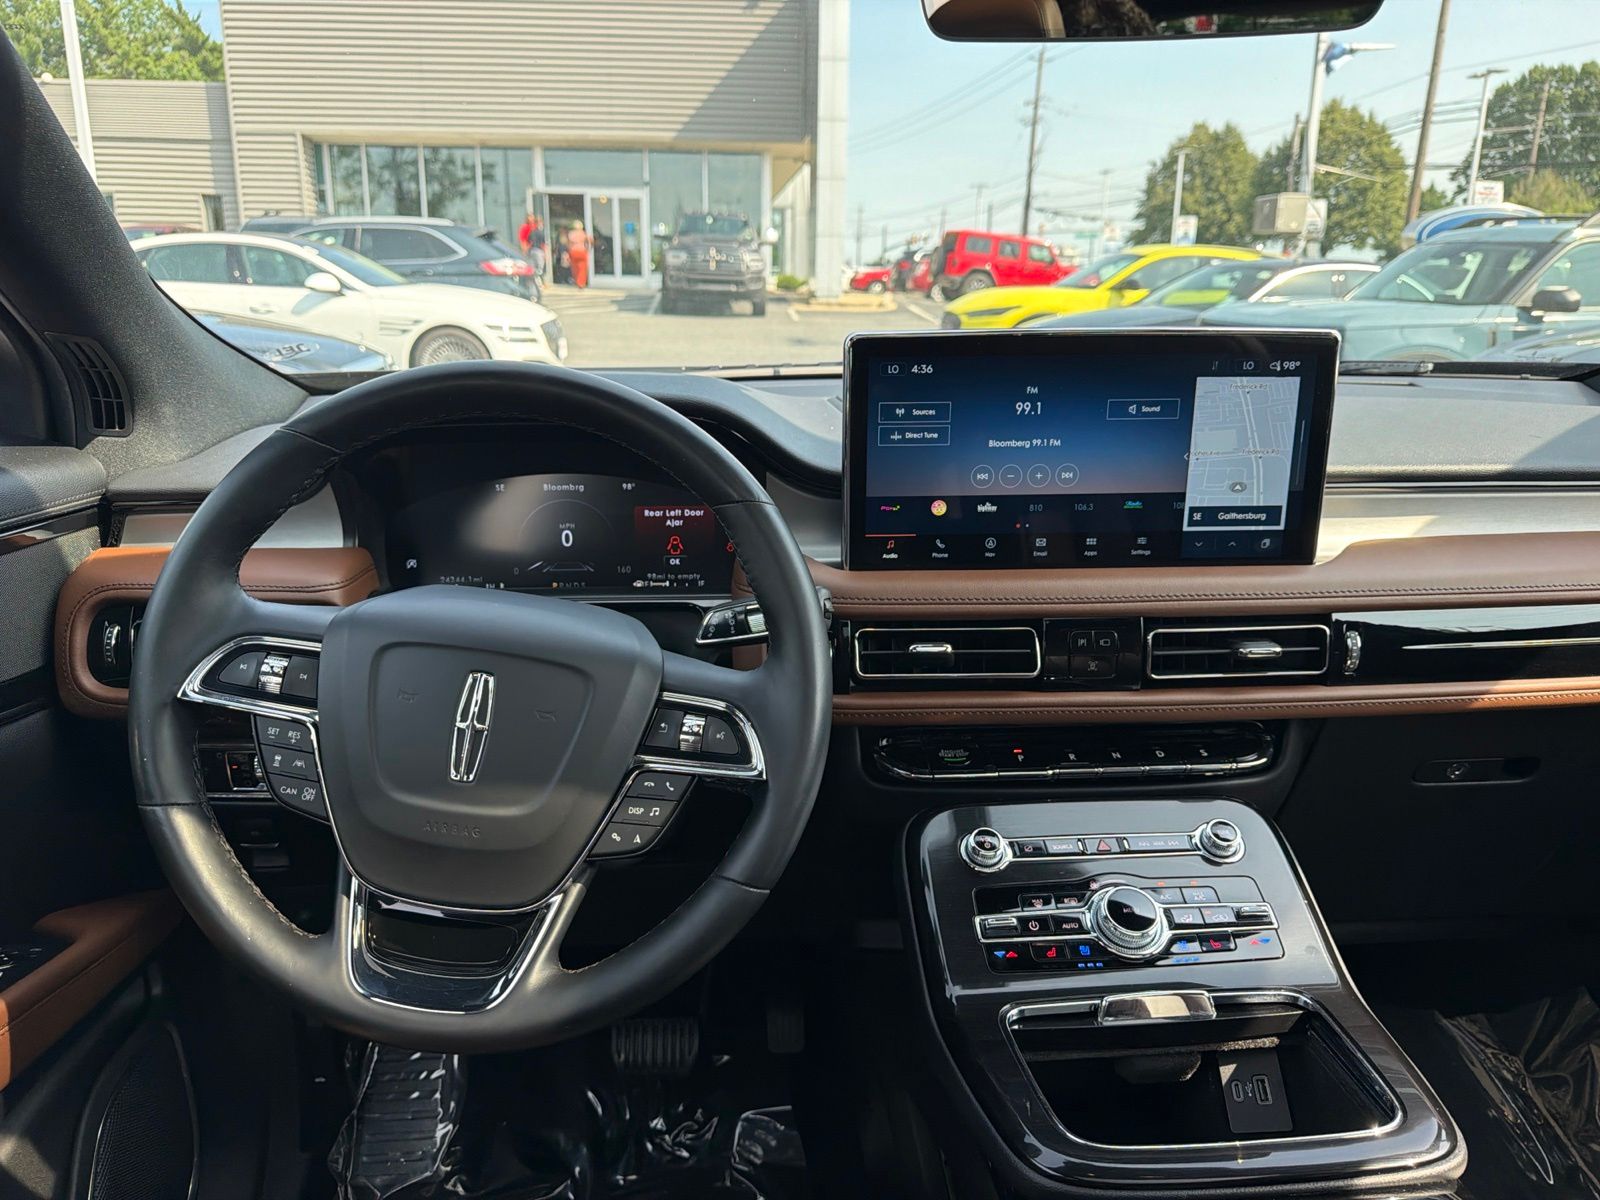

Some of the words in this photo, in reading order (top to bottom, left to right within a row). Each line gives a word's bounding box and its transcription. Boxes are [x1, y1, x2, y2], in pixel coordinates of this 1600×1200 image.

[887, 364, 899, 374] LO
[911, 364, 934, 374] 4:36
[1243, 361, 1255, 370] LO
[1026, 386, 1039, 394] FM
[912, 408, 936, 416] Sources
[1015, 401, 1042, 416] 99.1
[905, 431, 924, 439] Direct
[924, 431, 939, 439] Tune
[988, 439, 1031, 449] Bloomberg
[1032, 439, 1048, 447] 99.1
[1049, 439, 1061, 447] FM
[495, 484, 505, 492] SE
[543, 483, 585, 492] Bloombrg
[1029, 504, 1043, 512] 810
[1074, 503, 1094, 511] 106.3
[644, 509, 663, 517] Rear
[665, 509, 681, 517] Left
[684, 509, 704, 517] Door
[1192, 512, 1203, 520] SE
[1217, 511, 1267, 521] Gaithersburg
[666, 519, 683, 527] Ajar
[561, 529, 573, 547] 0
[617, 565, 632, 574] 160
[267, 727, 280, 735] SET
[287, 731, 301, 739] RES
[1068, 753, 1077, 761] R
[1155, 750, 1165, 758] D
[1199, 749, 1208, 757] S
[1017, 754, 1024, 762] P
[280, 785, 298, 795] CAN
[303, 786, 316, 795] ON
[301, 793, 315, 801] OFF
[628, 806, 645, 815] DISP
[423, 821, 481, 838] AIRBAG
